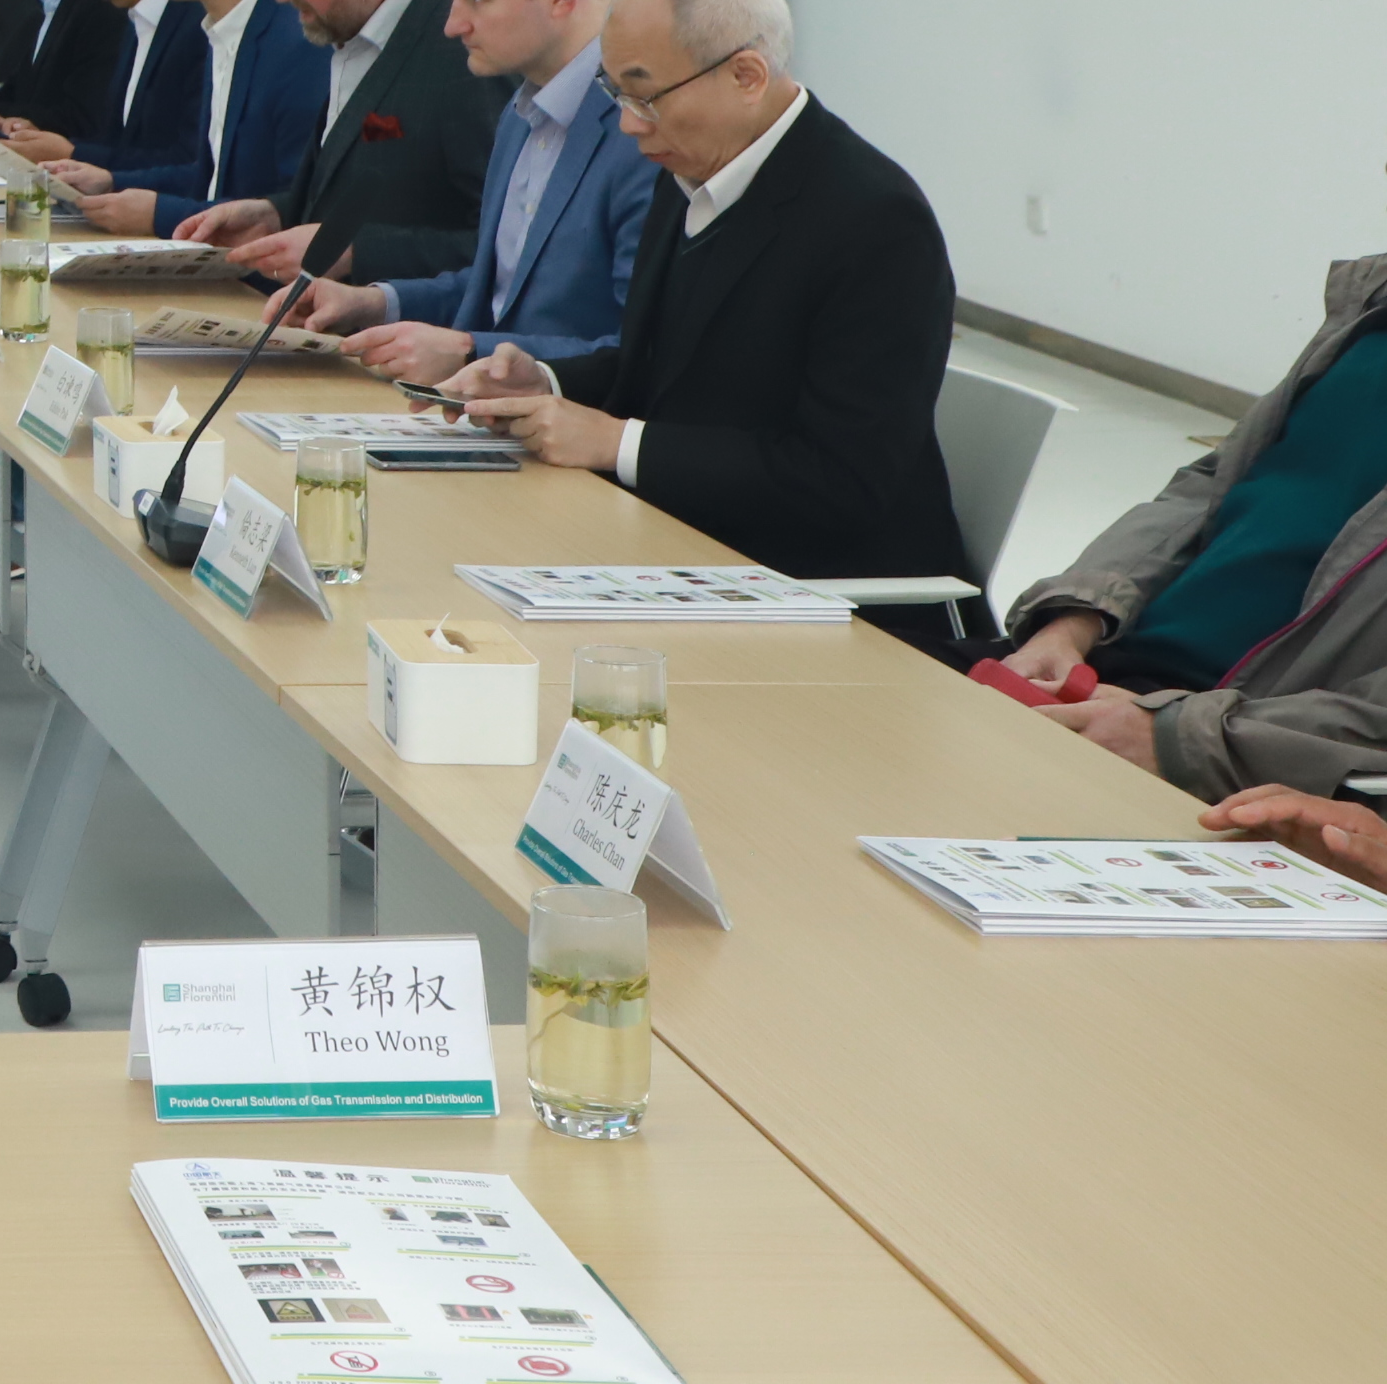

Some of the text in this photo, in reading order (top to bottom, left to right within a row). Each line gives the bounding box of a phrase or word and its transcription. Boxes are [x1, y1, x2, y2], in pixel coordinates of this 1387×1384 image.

[586, 773, 646, 840] 陈庆龙
[572, 818, 604, 855] Charles
[602, 841, 626, 871] Chan
[183, 983, 236, 994] Shanghai
[291, 965, 457, 1018] 黄锦权
[304, 1030, 451, 1057] Theo Wong
[170, 1093, 483, 1108] Provide Overall Solutions of Gas Transmission and Distribution
